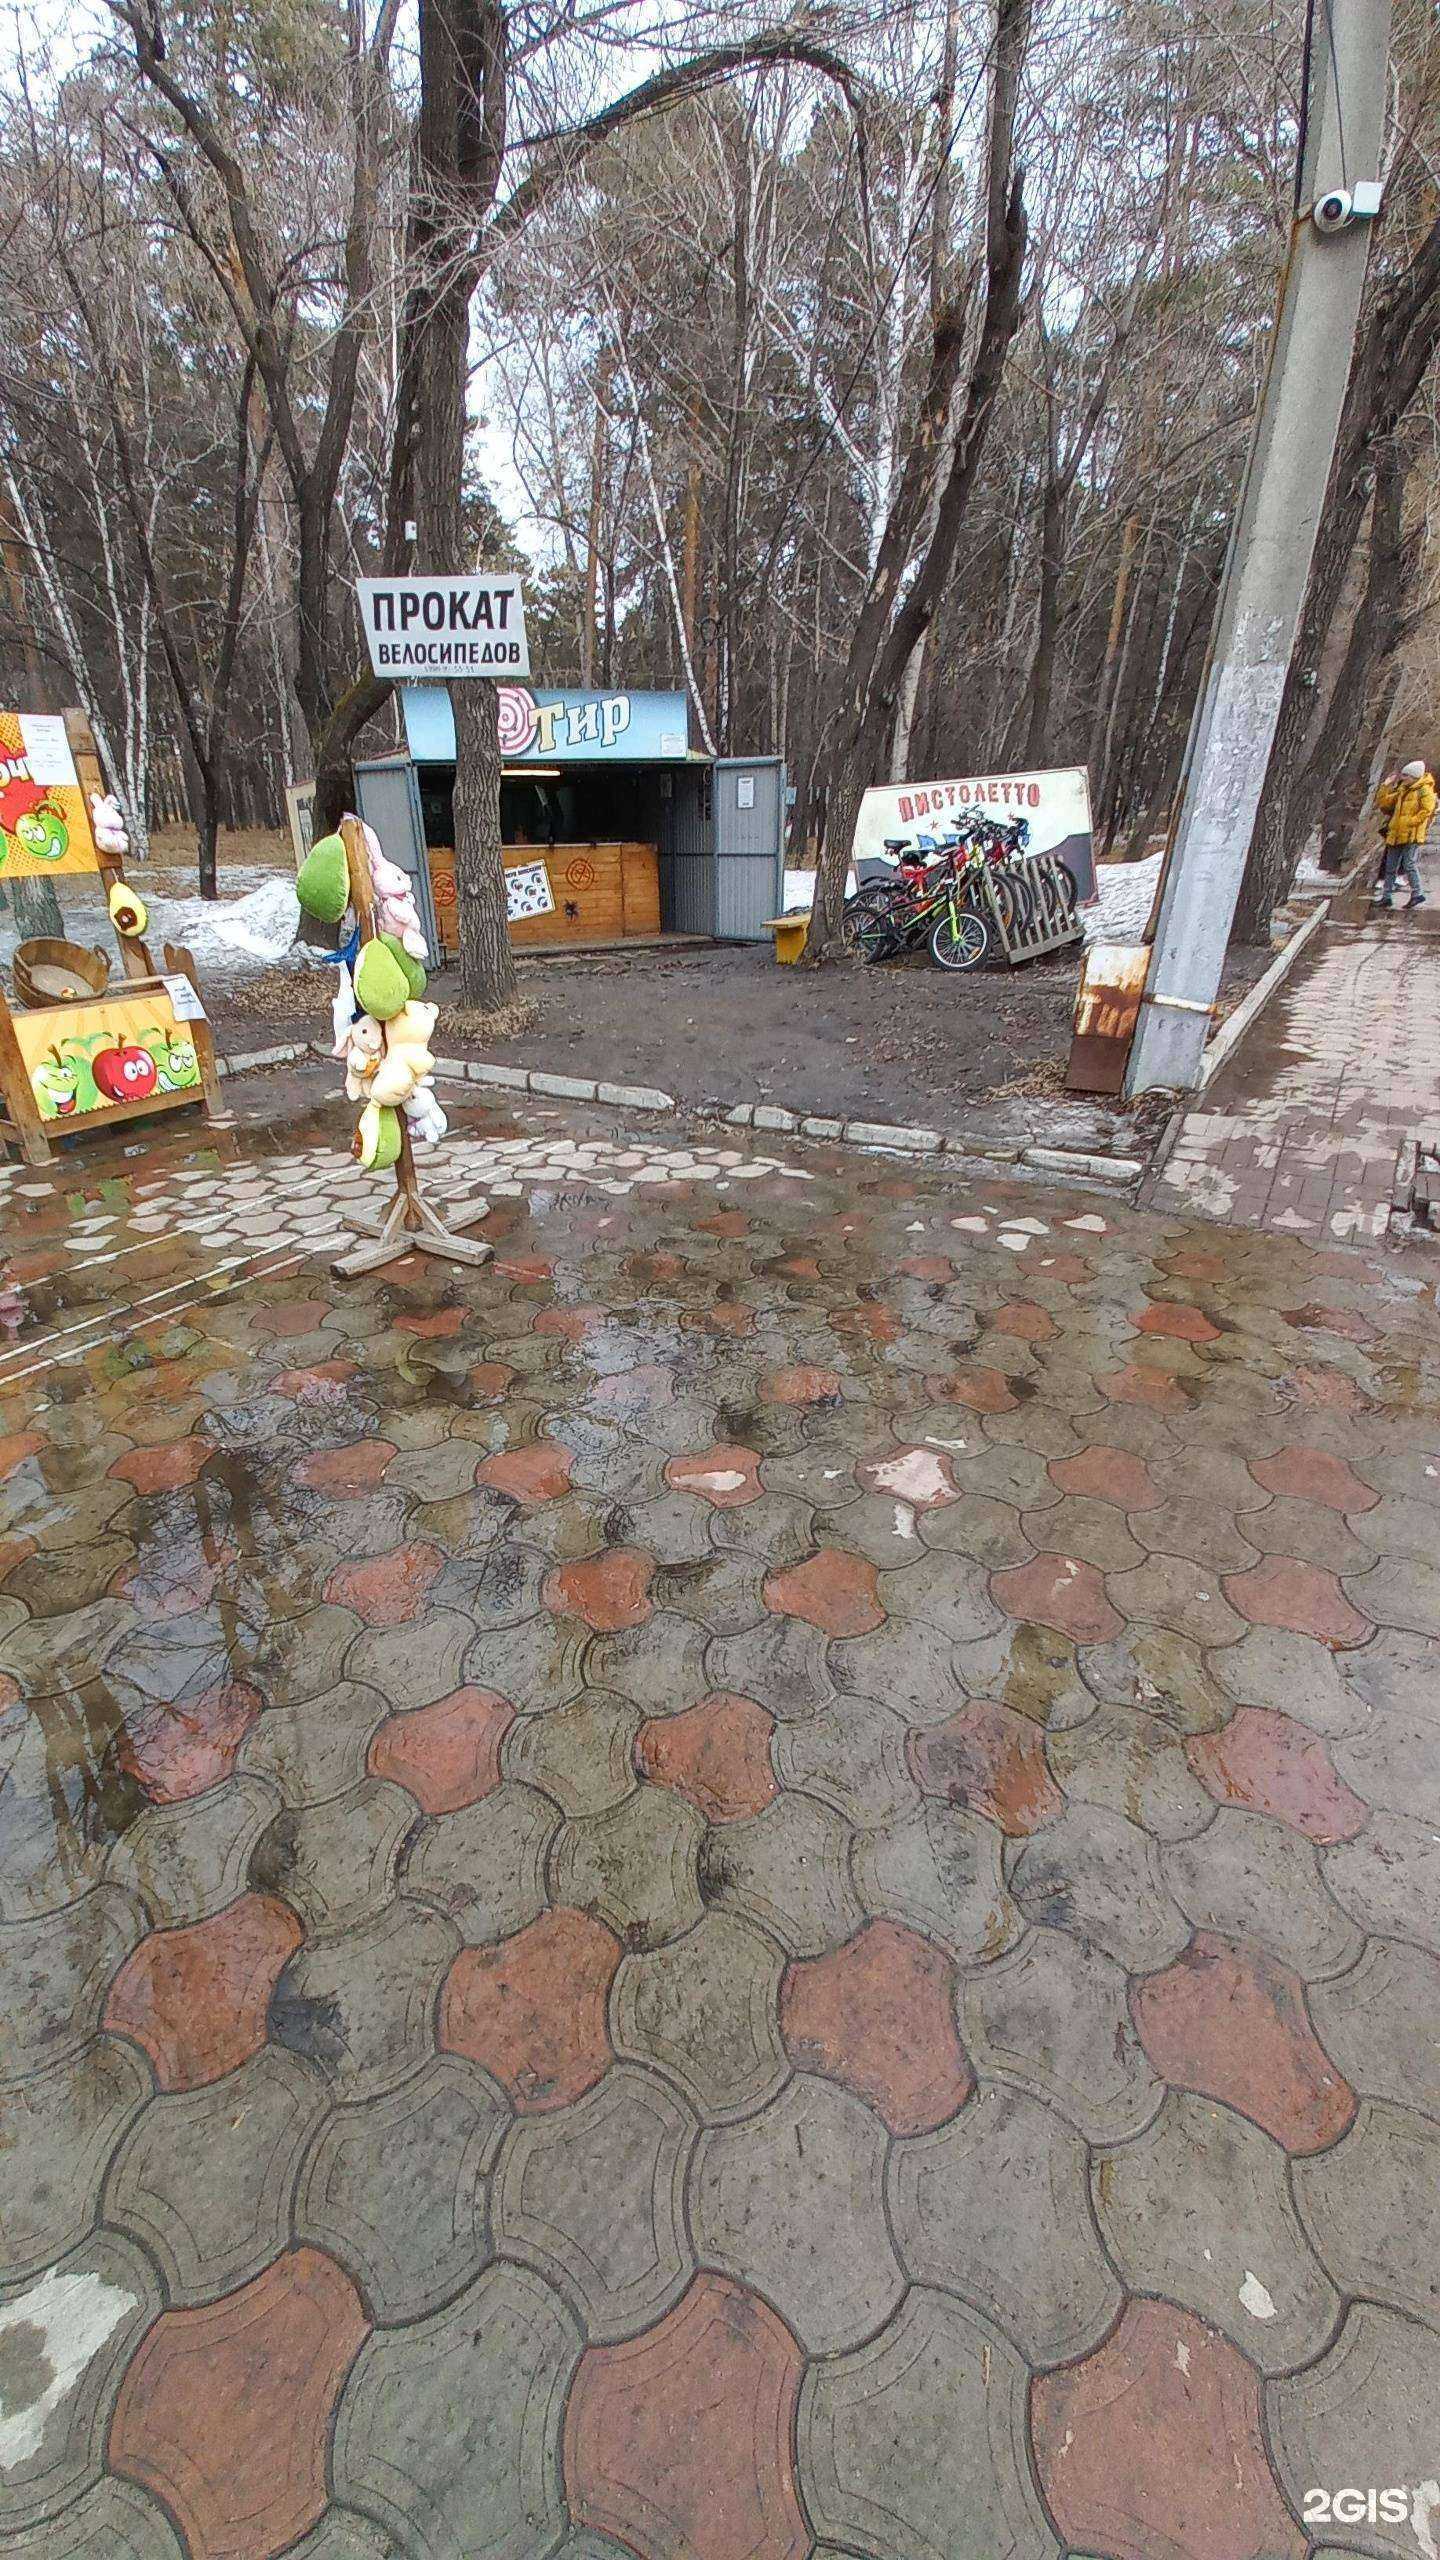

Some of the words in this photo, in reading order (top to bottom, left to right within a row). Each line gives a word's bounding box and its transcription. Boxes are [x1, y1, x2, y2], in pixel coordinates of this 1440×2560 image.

[372, 589, 515, 632] ПРОКАТ
[379, 642, 521, 664] ВЕЛОСИПЕДОВ
[898, 783, 1041, 823] ПИСТОЛЕТТО
